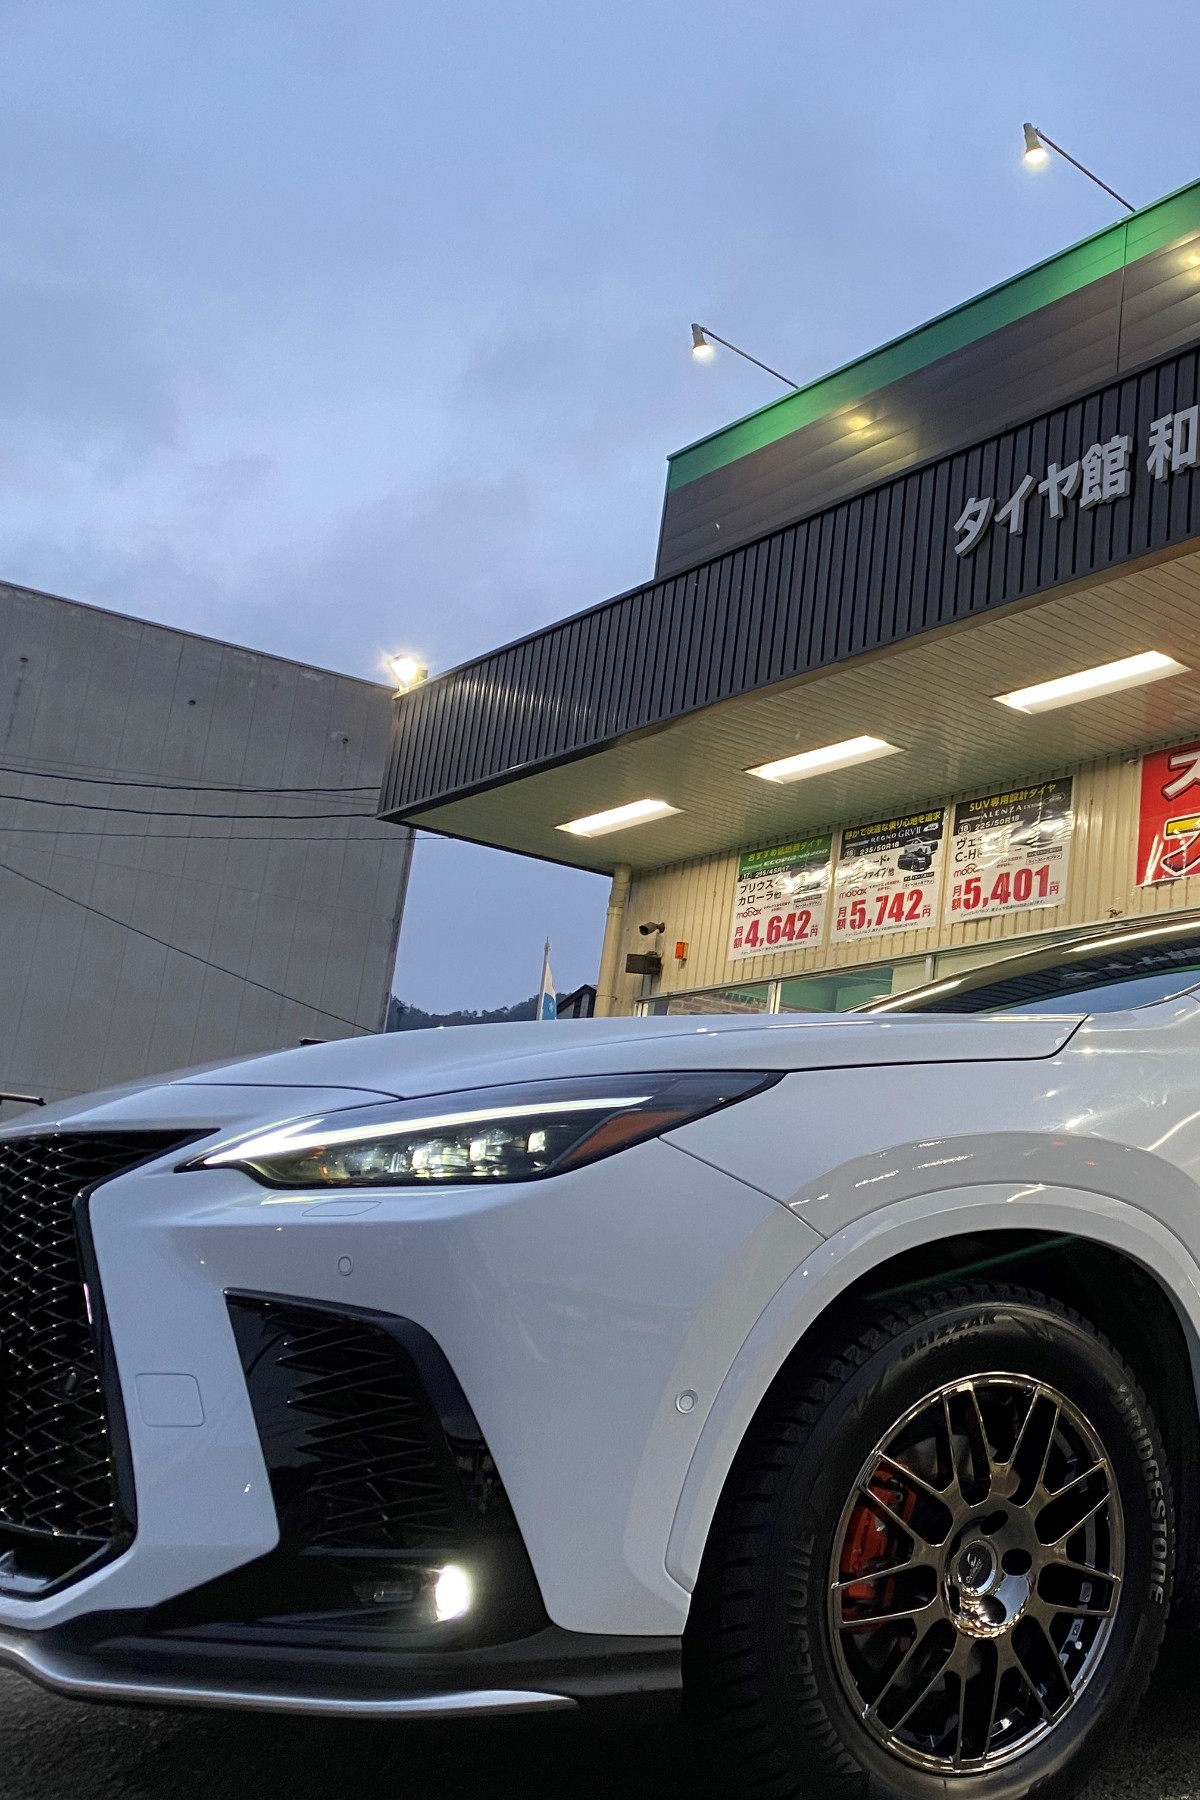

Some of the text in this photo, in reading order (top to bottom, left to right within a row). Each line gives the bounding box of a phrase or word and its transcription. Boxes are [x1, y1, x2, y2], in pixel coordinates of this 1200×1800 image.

[953, 434, 1133, 557] タイヤ館
[849, 889, 923, 930] 5,742
[922, 908, 931, 918] 円
[963, 865, 1050, 911] 5,401
[1050, 885, 1059, 895] 円
[744, 910, 812, 948] 4,642
[810, 927, 819, 937] 円
[1109, 1384, 1168, 1605] BRIDGESTONE
